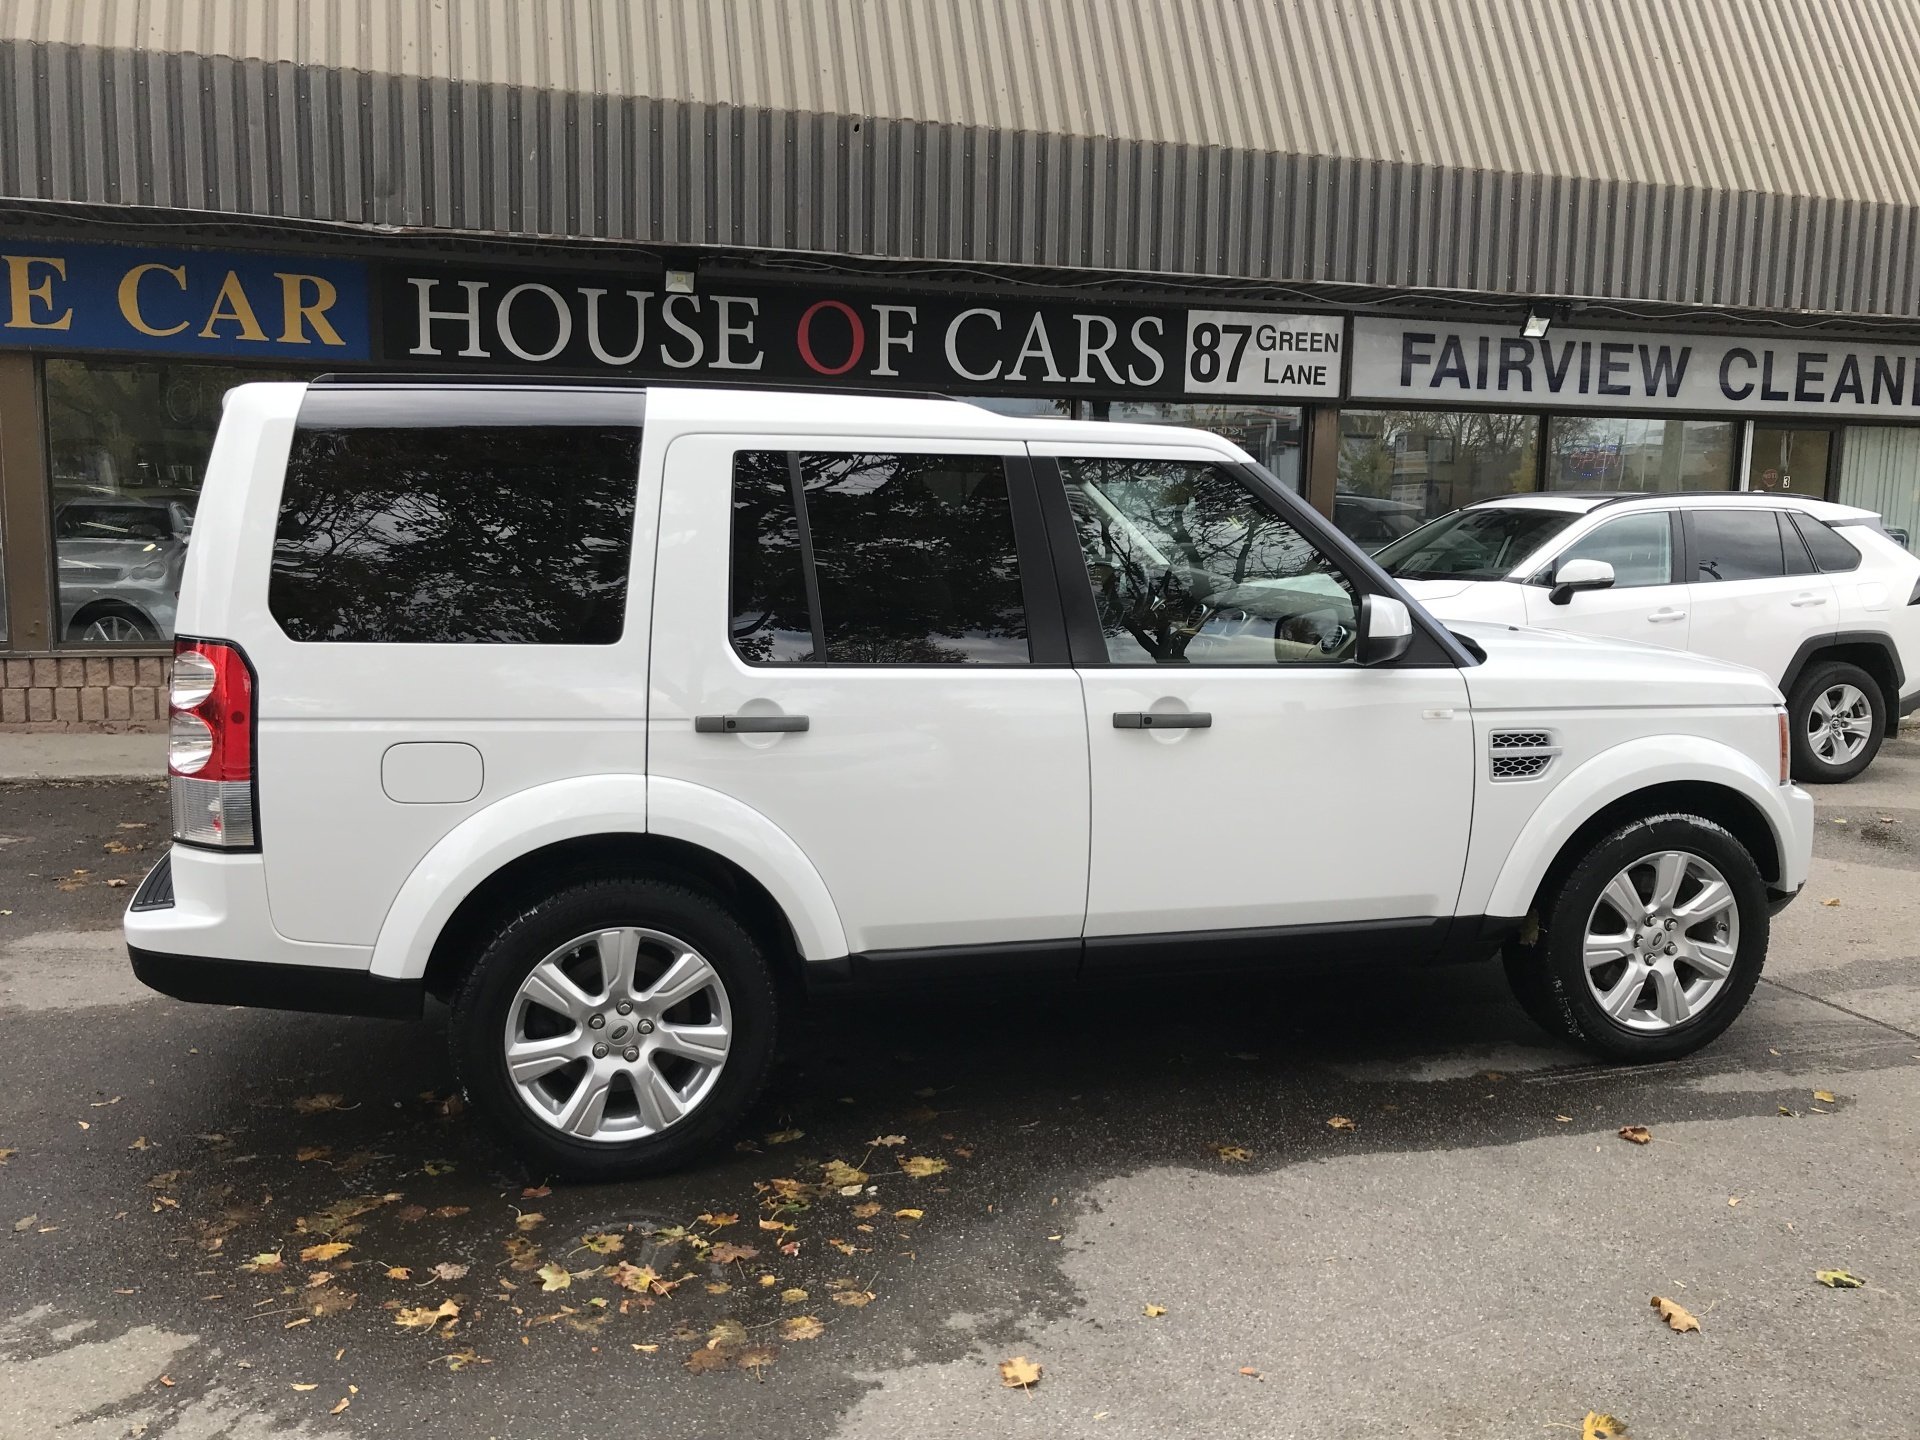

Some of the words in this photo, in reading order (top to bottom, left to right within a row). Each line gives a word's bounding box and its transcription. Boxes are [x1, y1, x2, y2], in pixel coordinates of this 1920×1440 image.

[1, 255, 73, 330] E
[117, 262, 347, 346] CAR
[407, 277, 765, 371] HOUSE
[797, 299, 918, 377] OF
[944, 308, 1165, 387] CARS
[1190, 322, 1253, 383] 87
[1256, 324, 1339, 353] GREEN
[1263, 357, 1327, 386] LANE
[1400, 332, 1692, 398] FAIRVIEW
[1569, 449, 1621, 471] OPEN
[1783, 476, 1790, 487] 3
